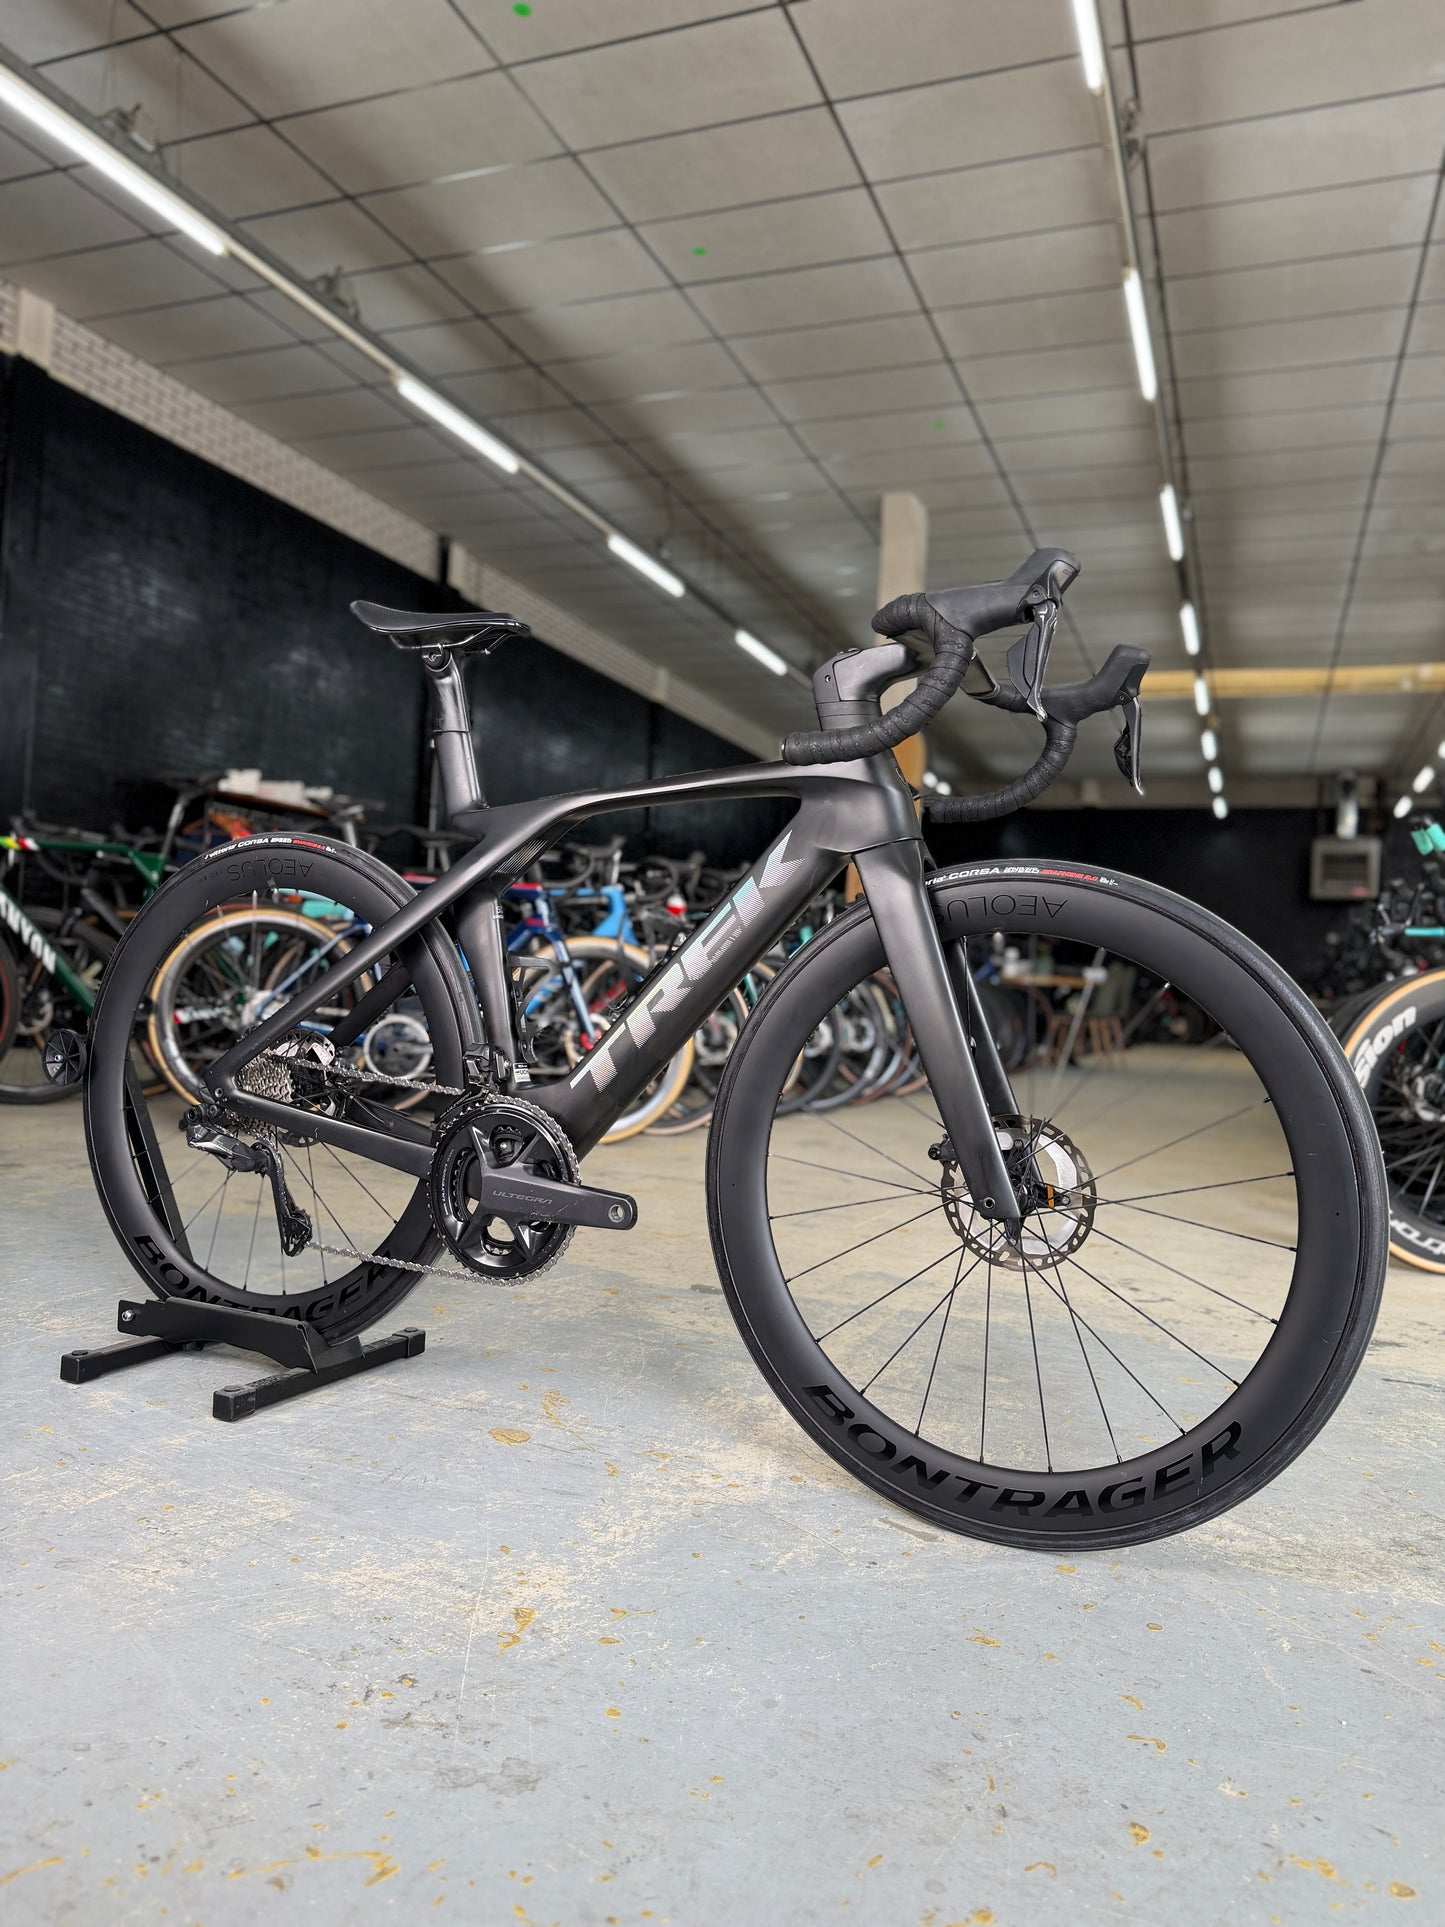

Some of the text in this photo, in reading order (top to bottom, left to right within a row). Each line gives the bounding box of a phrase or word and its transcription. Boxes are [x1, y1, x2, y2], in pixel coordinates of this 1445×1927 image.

[238, 837, 269, 848] CORSA
[226, 857, 314, 881] AEOLUS
[948, 867, 1000, 880] CORSA
[569, 829, 806, 1094] TREK
[492, 1190, 553, 1205] ULTEGRA
[801, 1384, 1242, 1518] BONTRAGER
